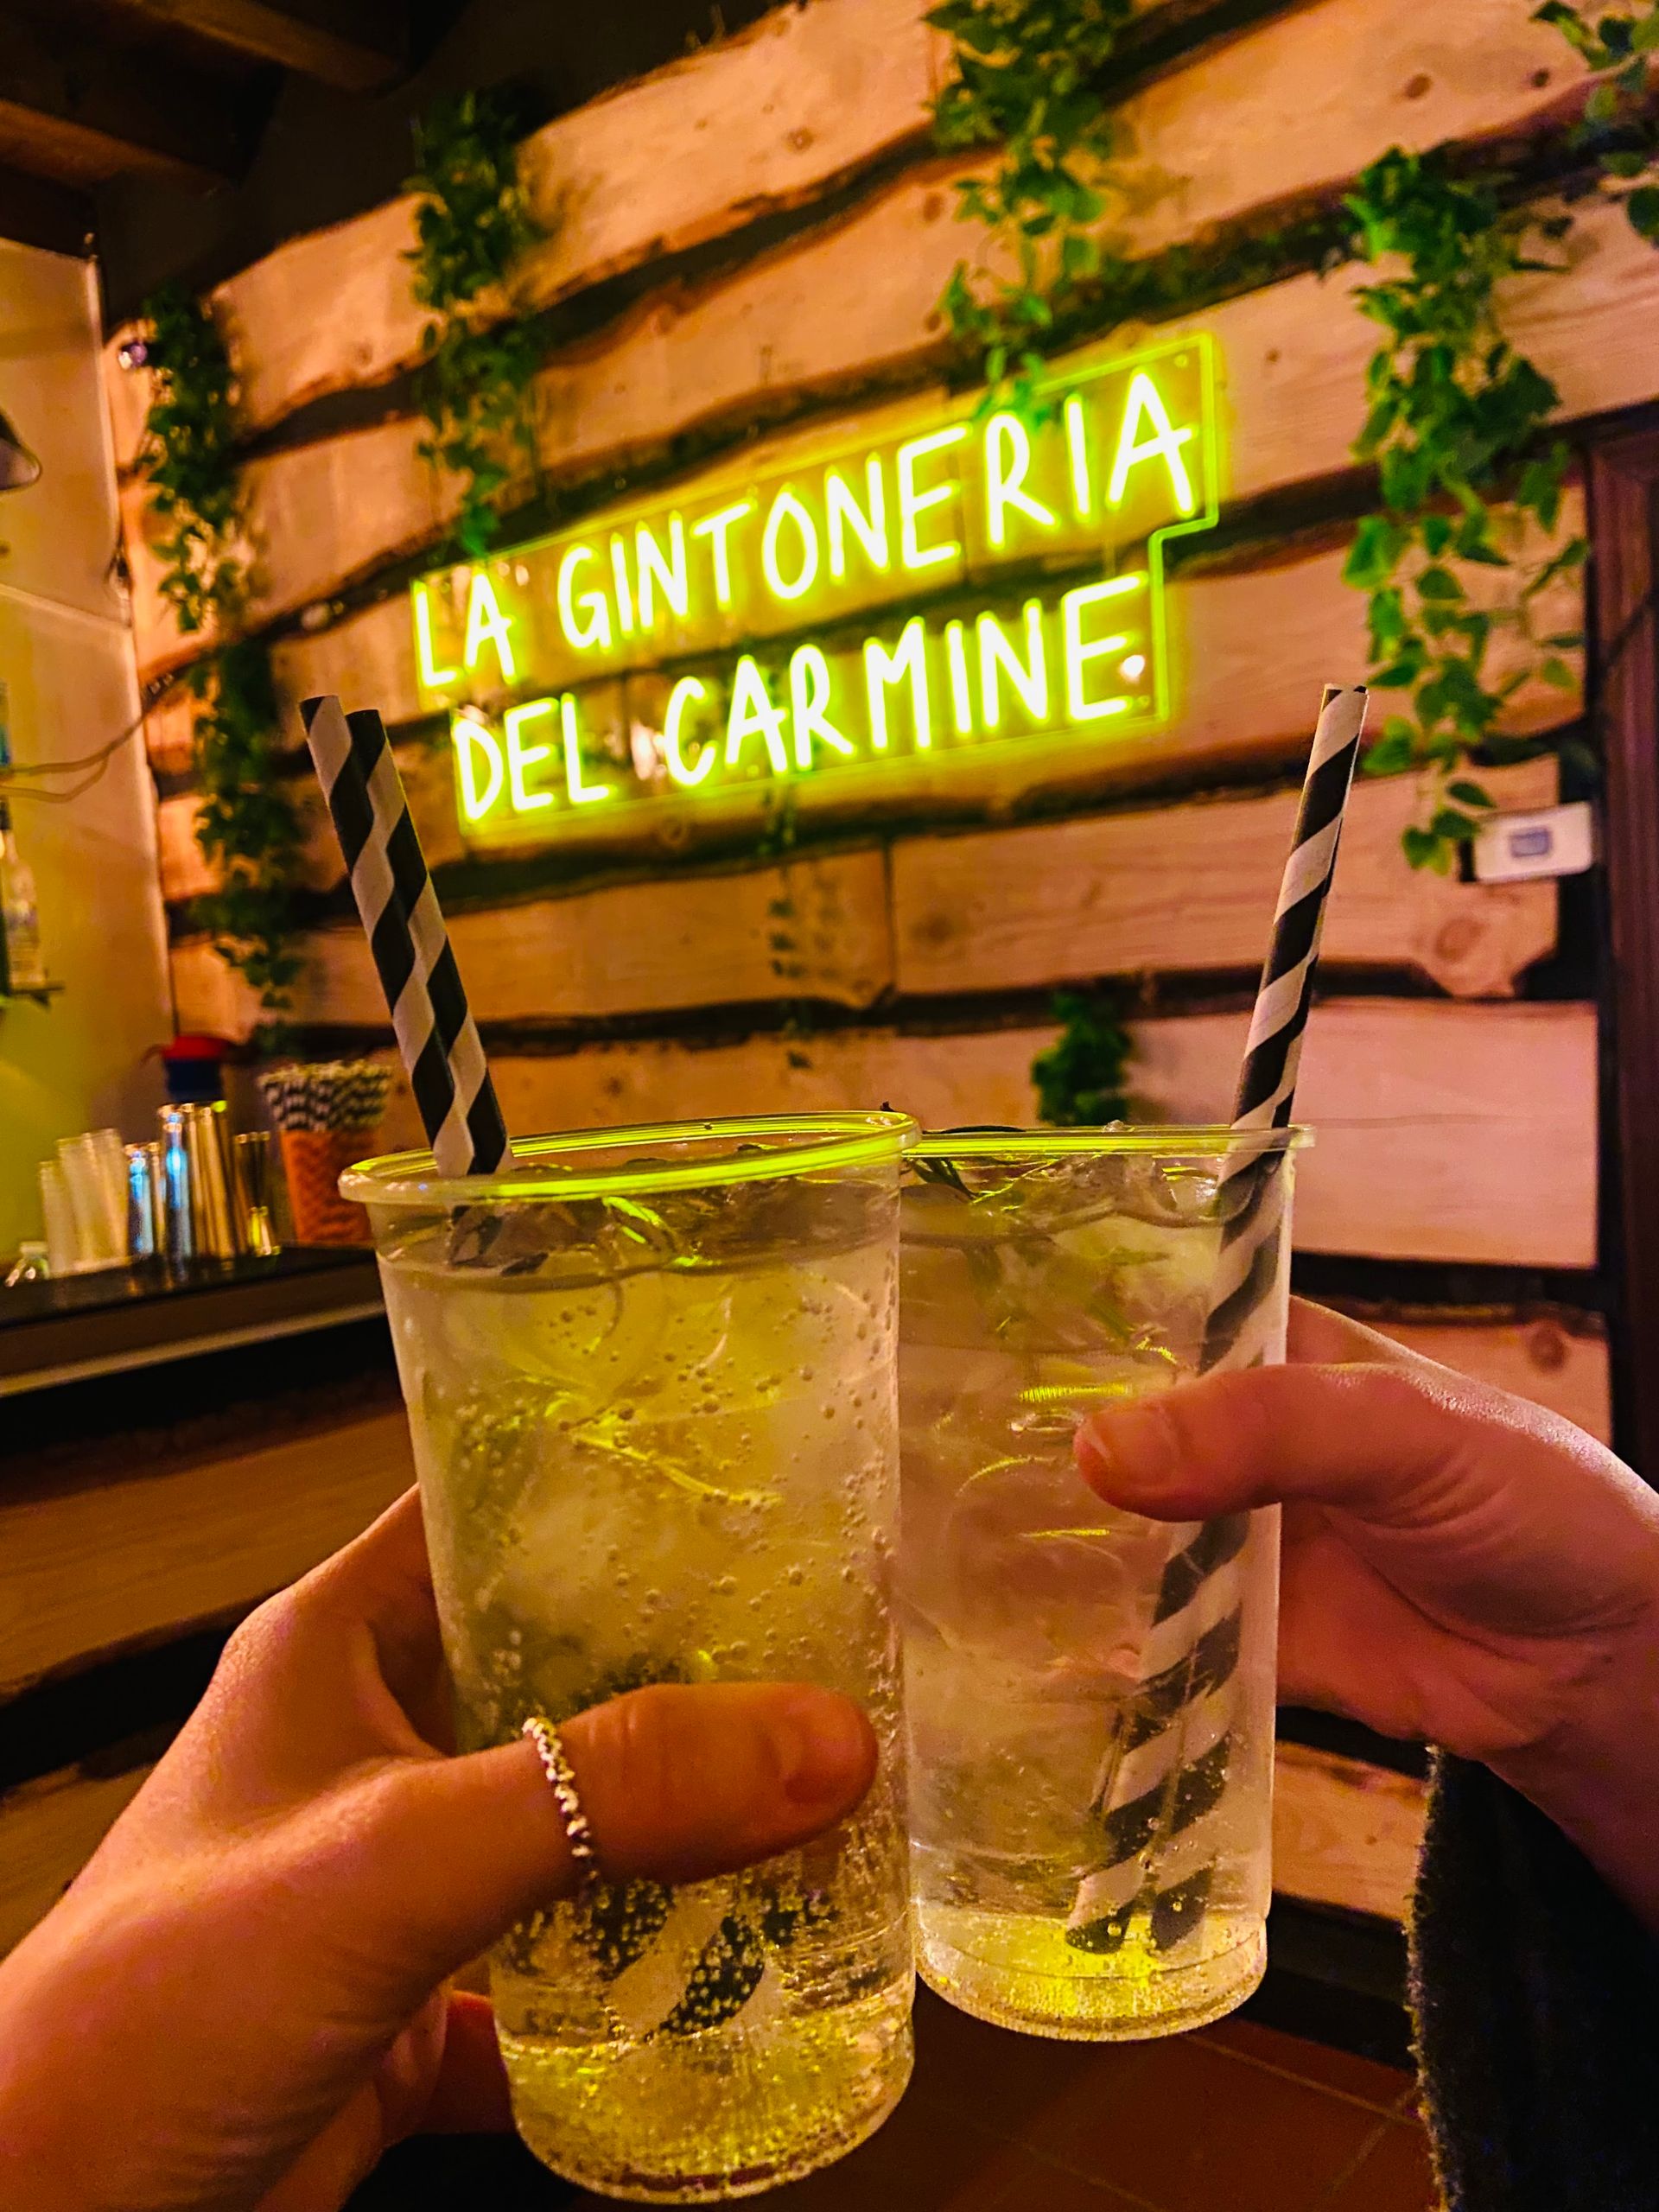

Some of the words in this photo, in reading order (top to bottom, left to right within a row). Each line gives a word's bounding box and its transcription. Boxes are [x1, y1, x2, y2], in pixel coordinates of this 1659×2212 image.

[412, 568, 517, 689] LA
[556, 367, 1198, 652] GINTONERIA
[451, 693, 615, 822] DEL
[664, 571, 1150, 788] CARMINE
